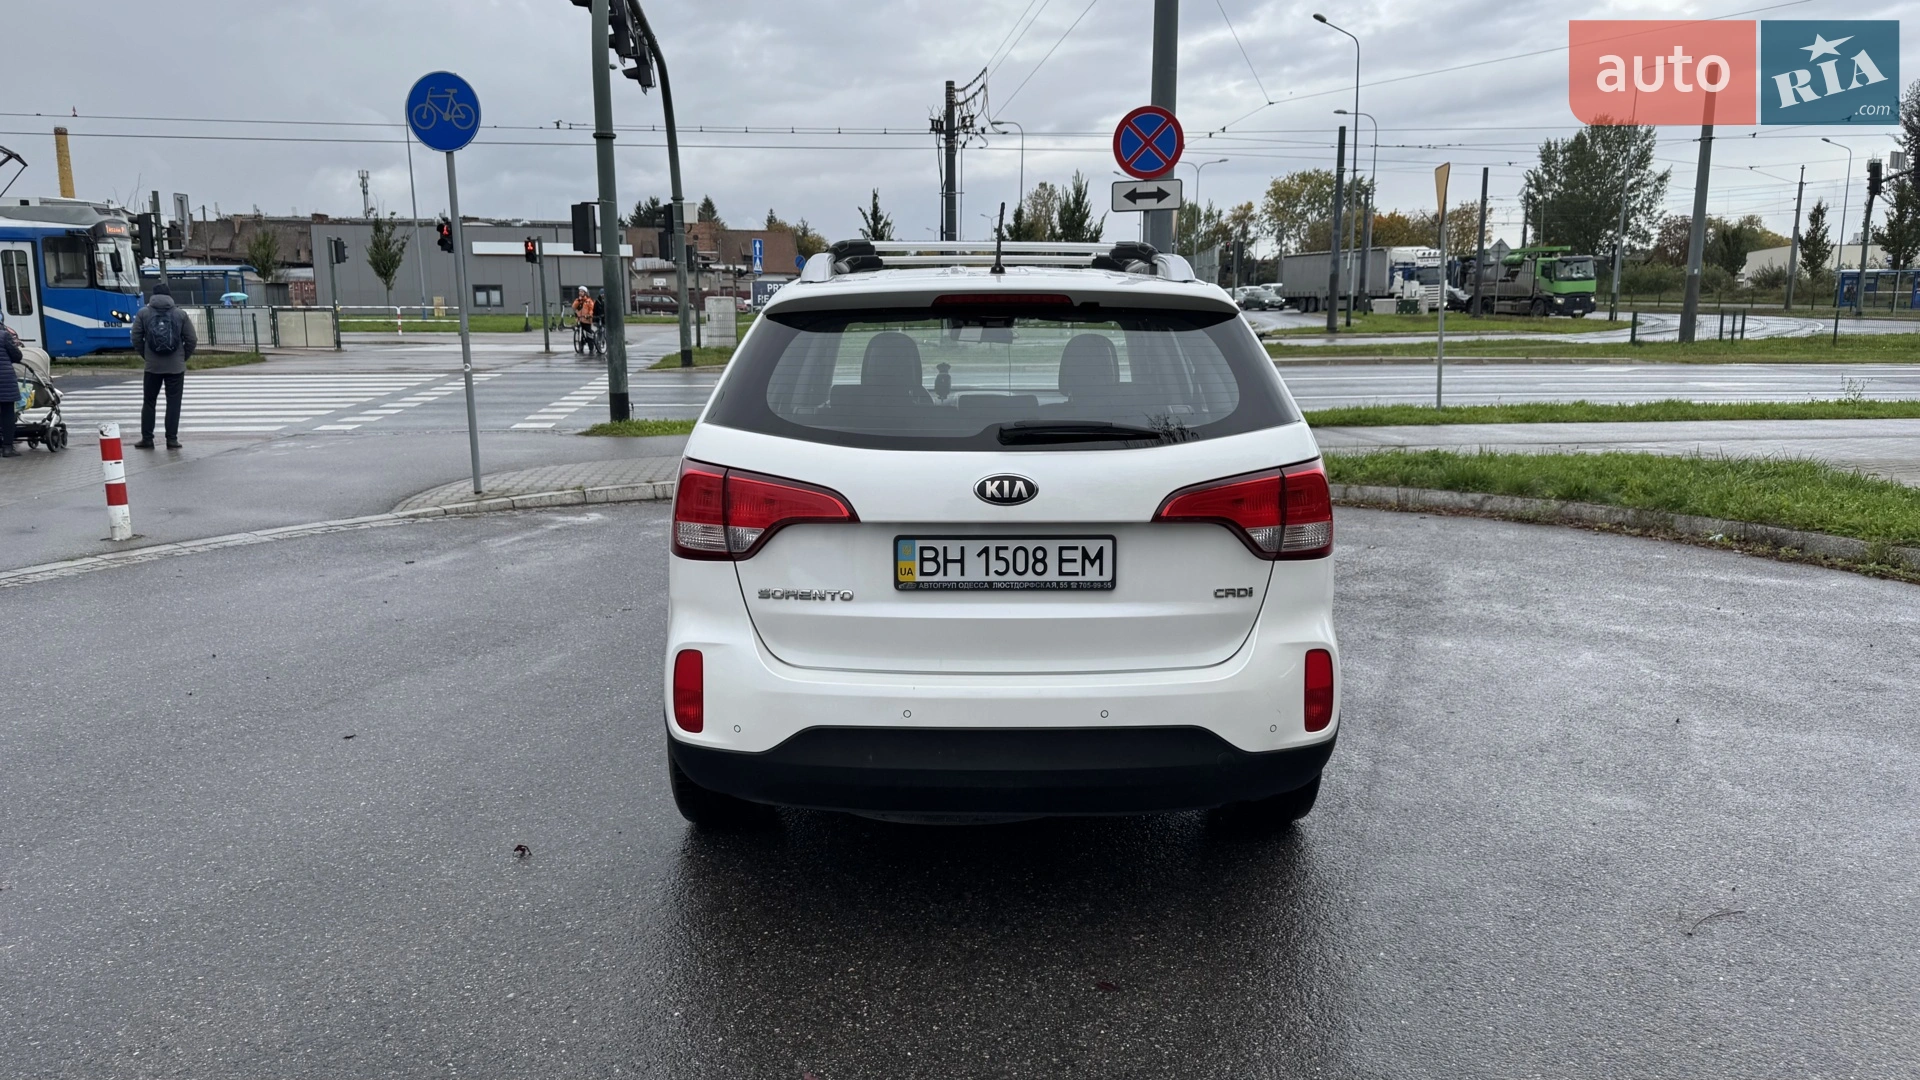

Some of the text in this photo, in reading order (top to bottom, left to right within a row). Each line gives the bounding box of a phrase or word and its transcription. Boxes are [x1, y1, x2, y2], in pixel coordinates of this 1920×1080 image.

[985, 480, 1029, 498] KIA
[976, 545, 1048, 577] 1508
[1058, 545, 1104, 577] EM
[900, 568, 914, 576] UA
[757, 588, 854, 601] SORENTO
[1213, 586, 1254, 599] CRDi
